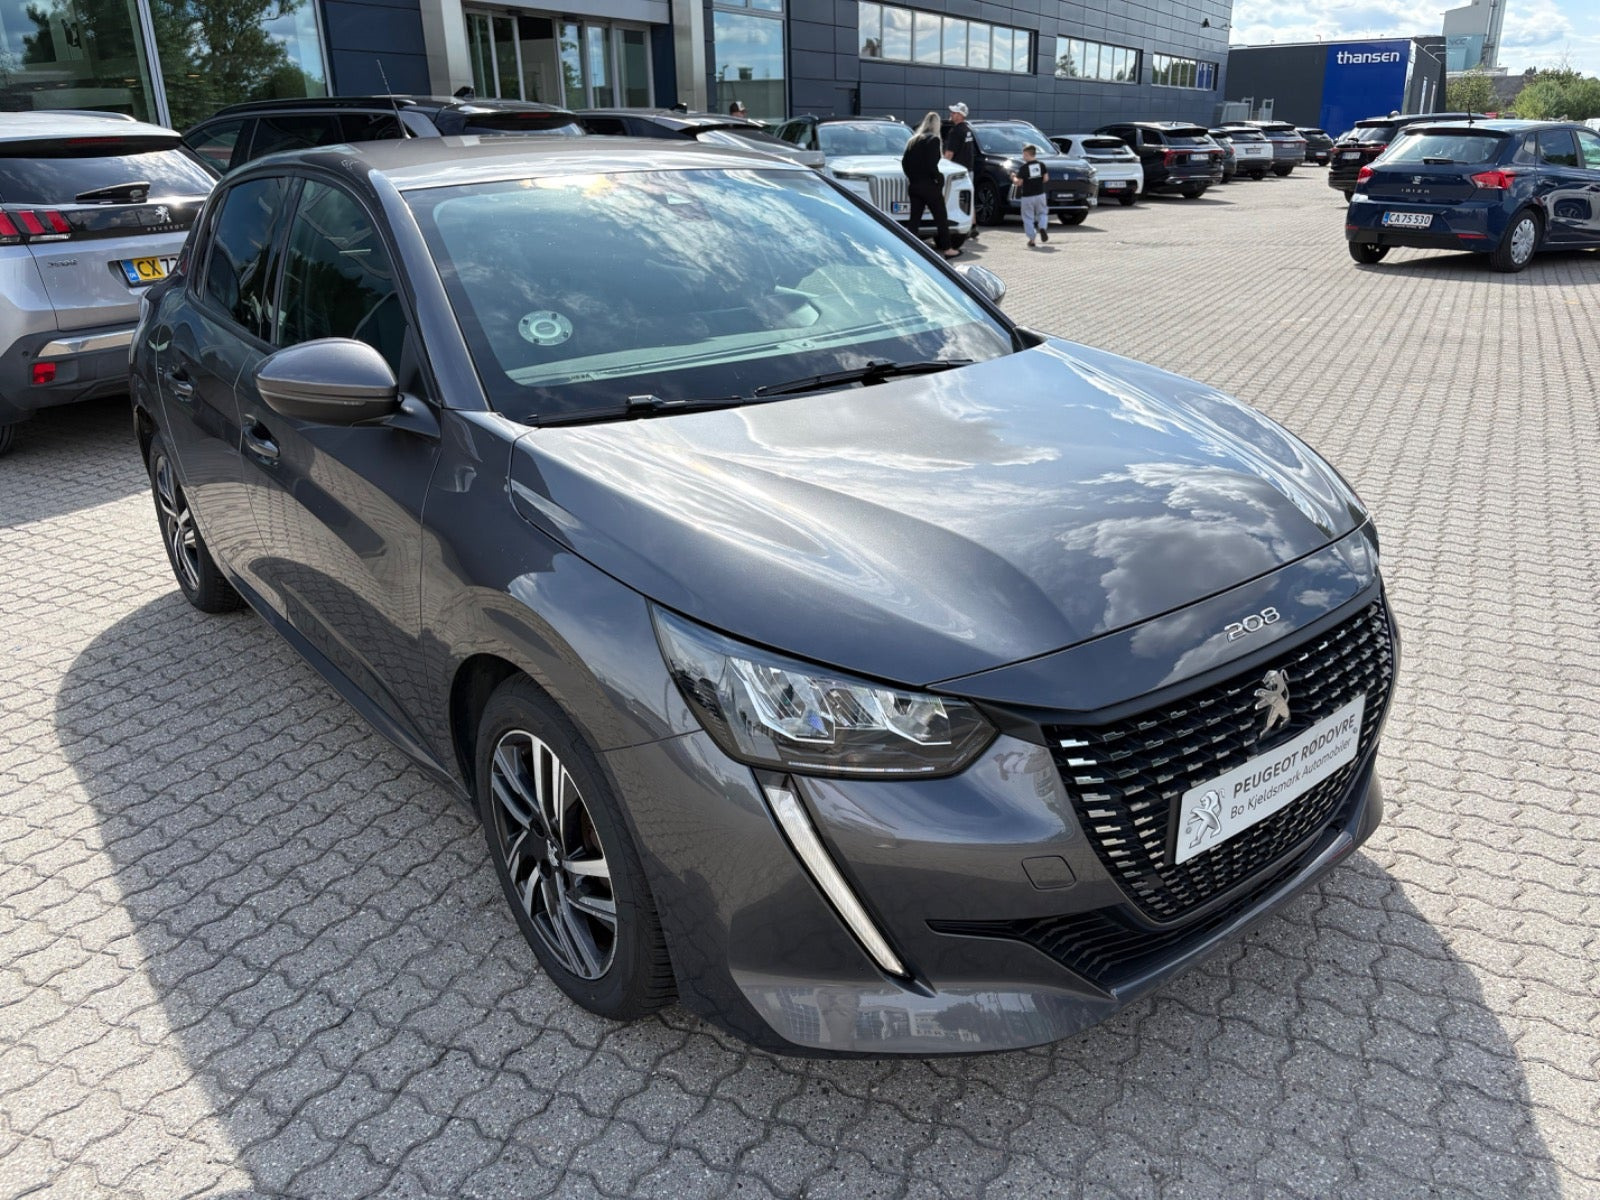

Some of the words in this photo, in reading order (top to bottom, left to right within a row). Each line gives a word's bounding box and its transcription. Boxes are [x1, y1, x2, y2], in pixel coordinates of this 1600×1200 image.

[1336, 50, 1400, 65] thansen
[147, 223, 185, 232] PEUGEOT
[1389, 213, 1400, 223] CA
[1402, 214, 1412, 223] 75
[1414, 215, 1431, 225] 530
[137, 259, 162, 277] CX
[1224, 606, 1281, 643] 208
[1233, 750, 1299, 799] PEUGEOT
[1300, 713, 1356, 761] RØDOVRE
[1230, 804, 1245, 819] Bo
[1246, 770, 1300, 811] Kjeldsmark
[1301, 736, 1352, 779] Automobiler
